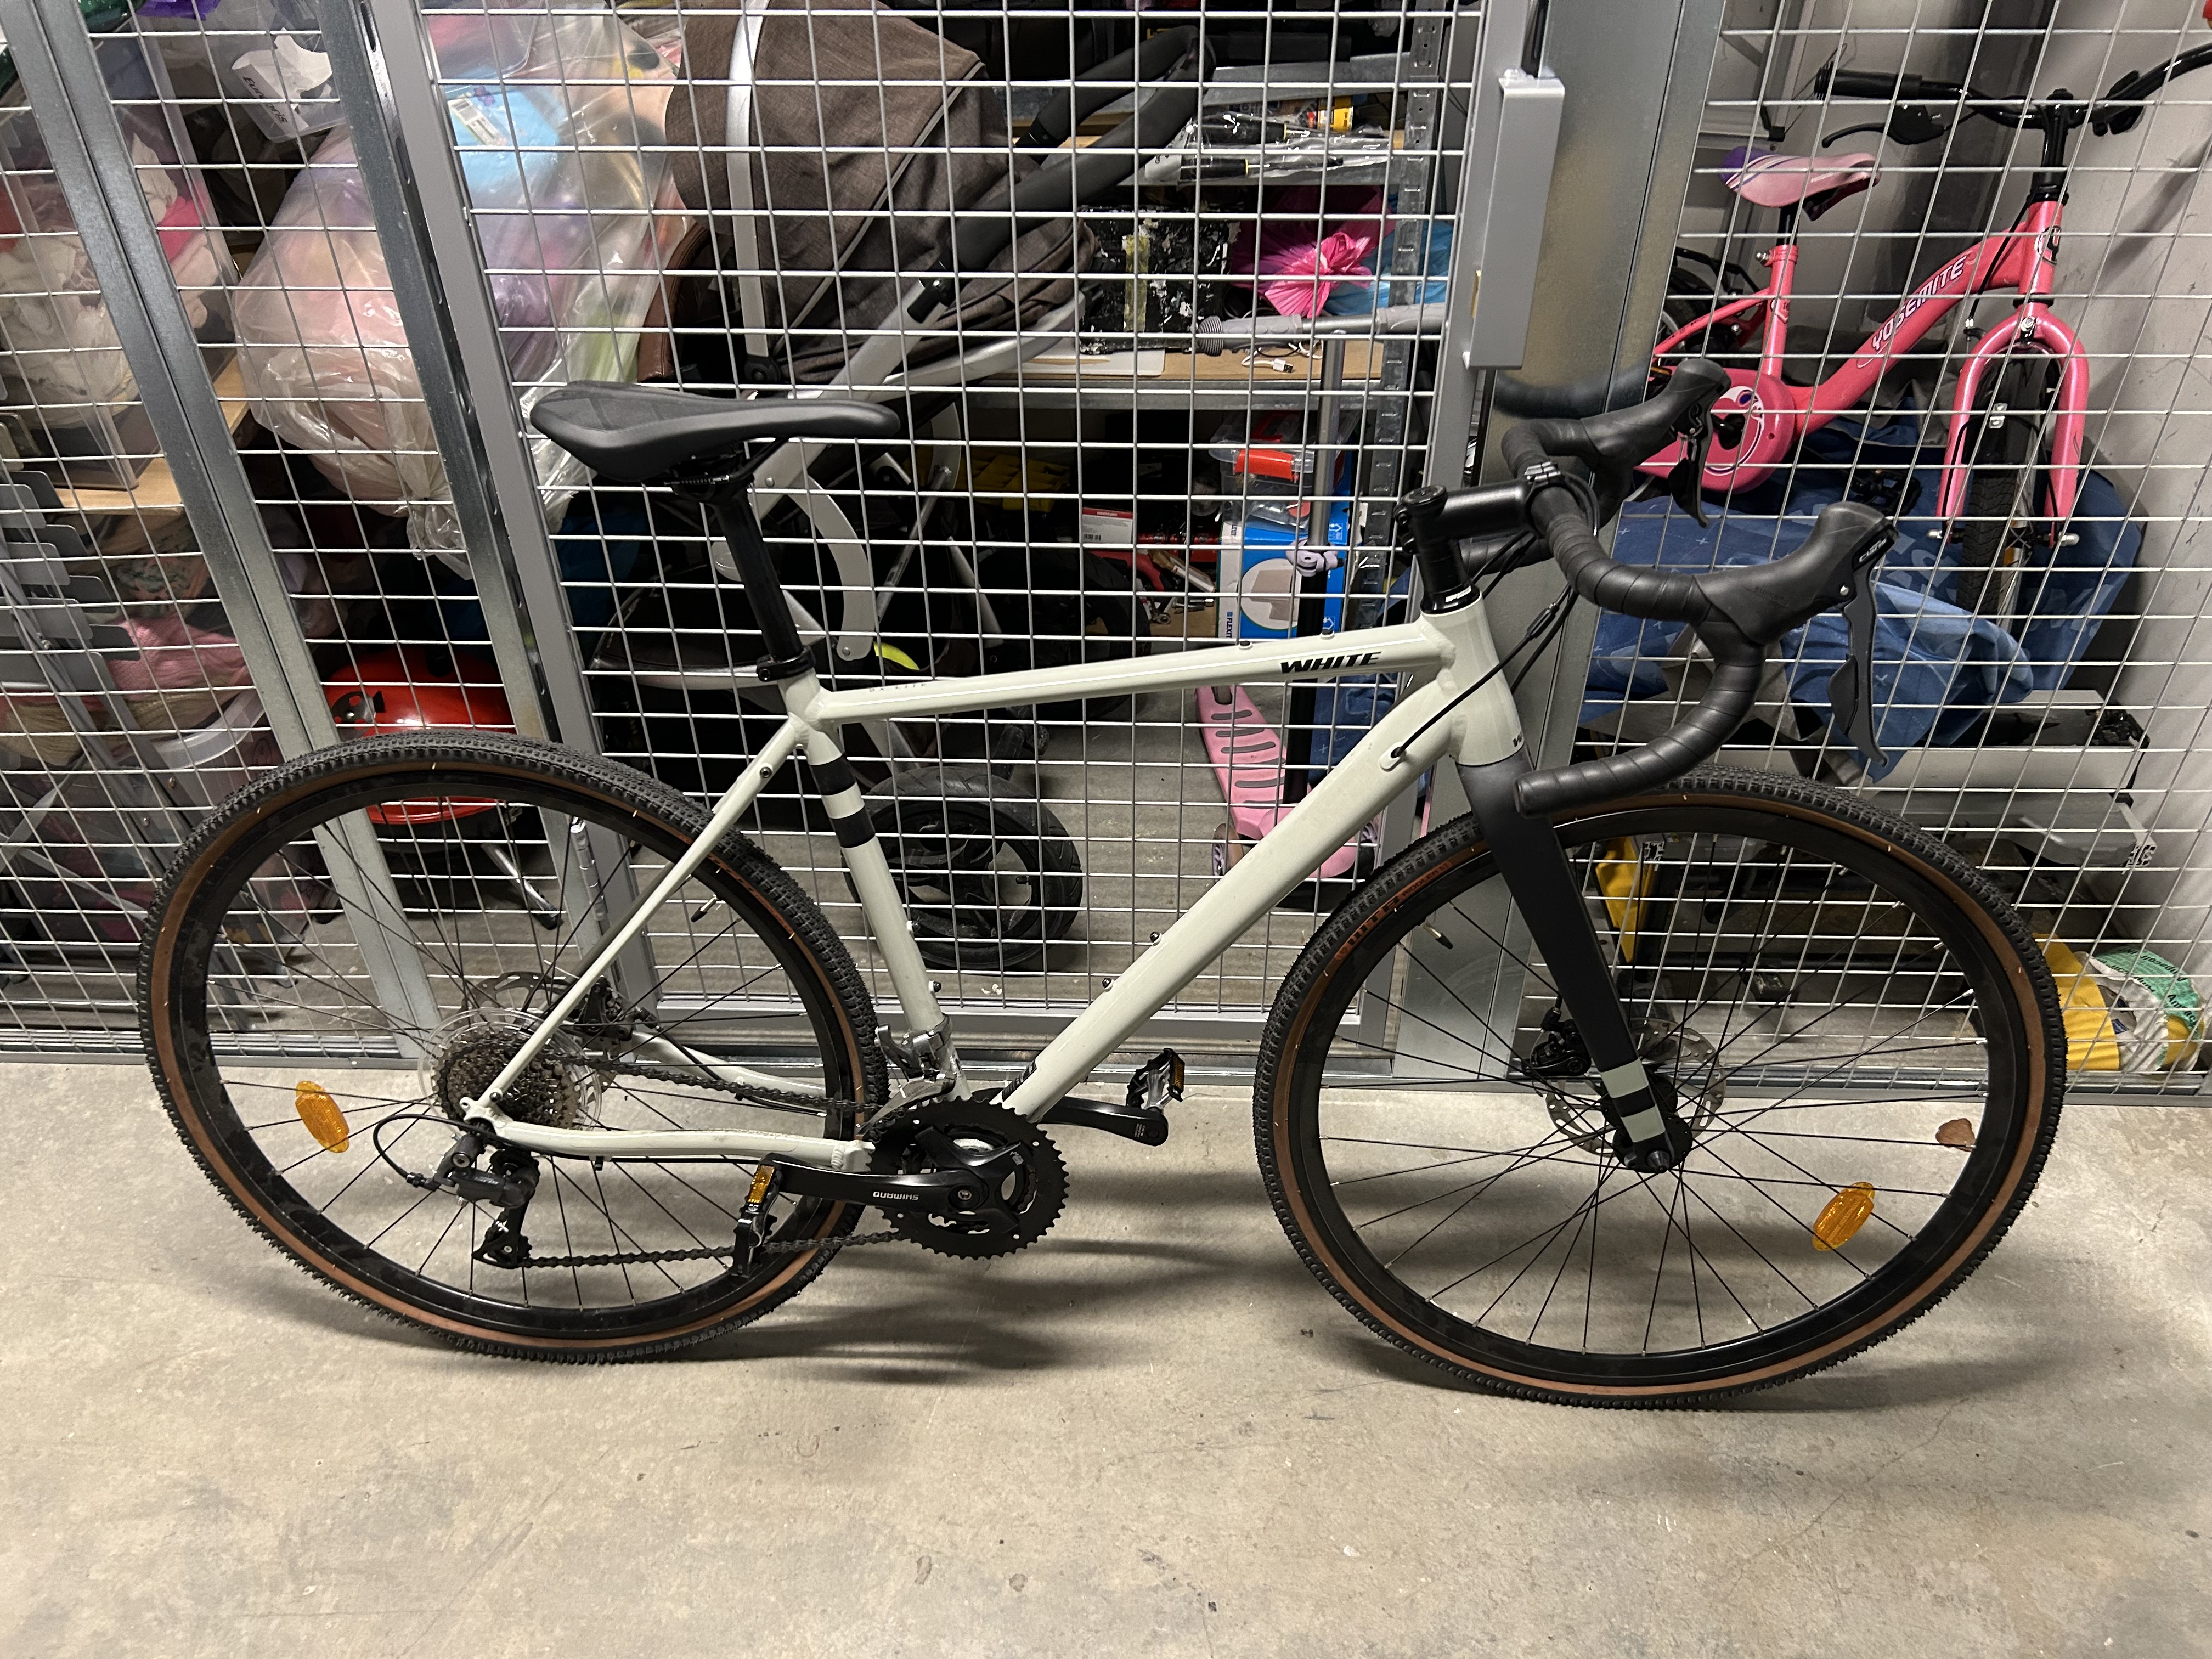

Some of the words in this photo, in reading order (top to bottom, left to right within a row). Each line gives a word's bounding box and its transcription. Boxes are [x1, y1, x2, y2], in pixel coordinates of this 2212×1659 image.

[1871, 254, 1968, 351] YOSEMITE
[1280, 651, 1382, 674] WHITE
[1347, 895, 1400, 946] WTB
[1402, 869, 1440, 898] RIDDLER
[872, 1190, 920, 1201] SHIMANO
